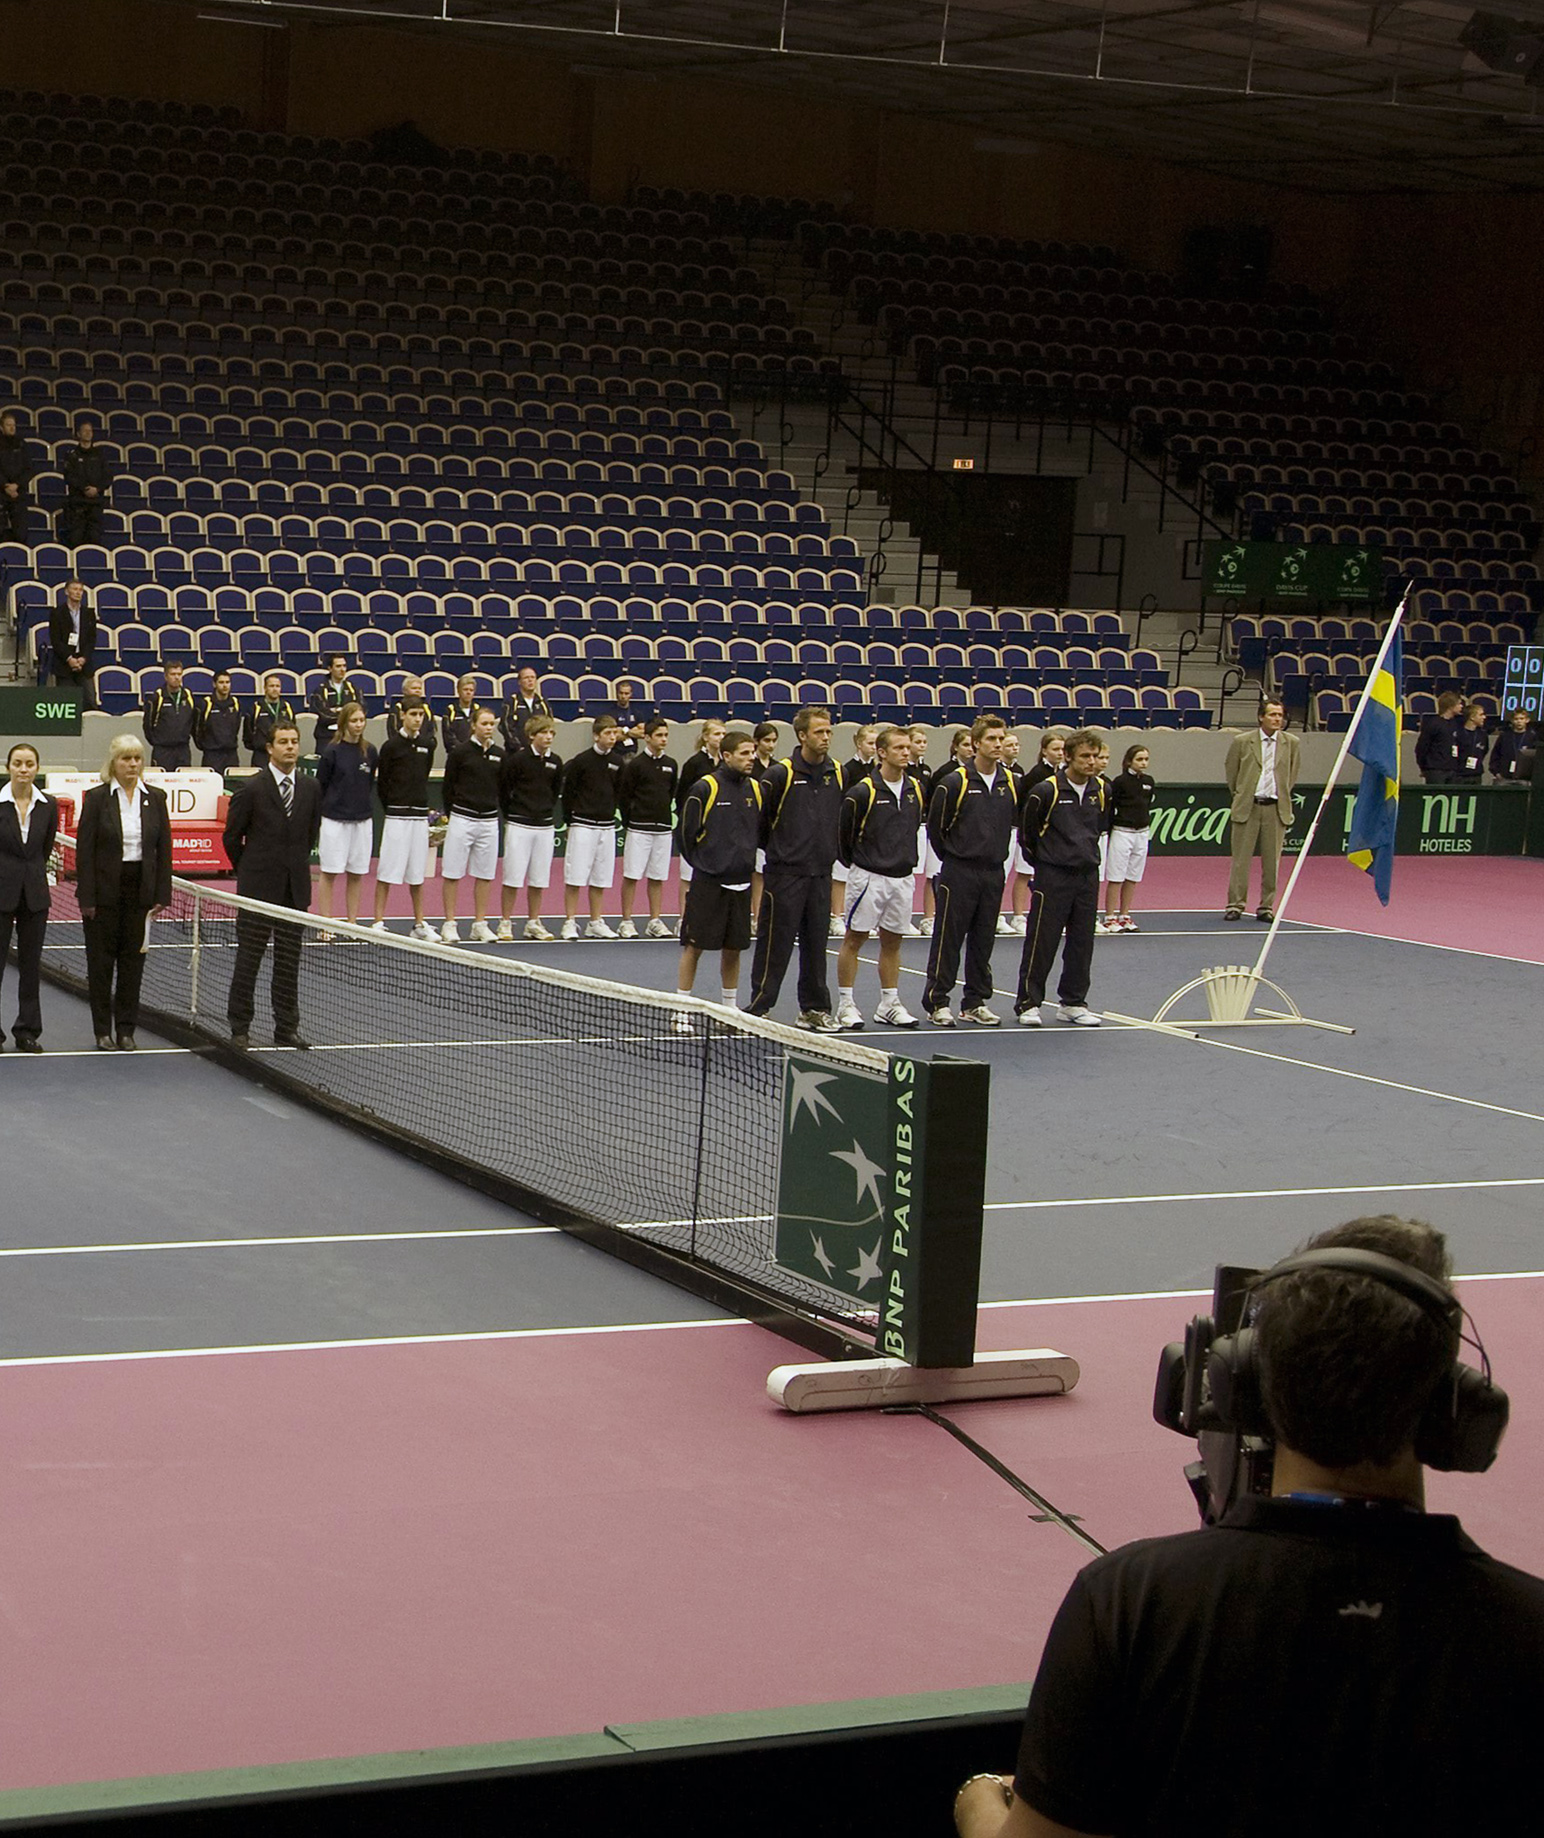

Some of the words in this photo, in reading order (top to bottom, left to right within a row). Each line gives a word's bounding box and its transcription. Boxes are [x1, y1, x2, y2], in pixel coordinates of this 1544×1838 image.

[1511, 657, 1522, 673] 0
[1529, 658, 1541, 674] 0
[35, 703, 76, 719] SWE
[1506, 696, 1518, 711] 0
[1525, 697, 1537, 712] 0
[172, 838, 212, 848] MADRID
[1419, 838, 1473, 852] HOTELES
[892, 1060, 915, 1257] PARIBAS
[884, 1269, 905, 1358] BNP
